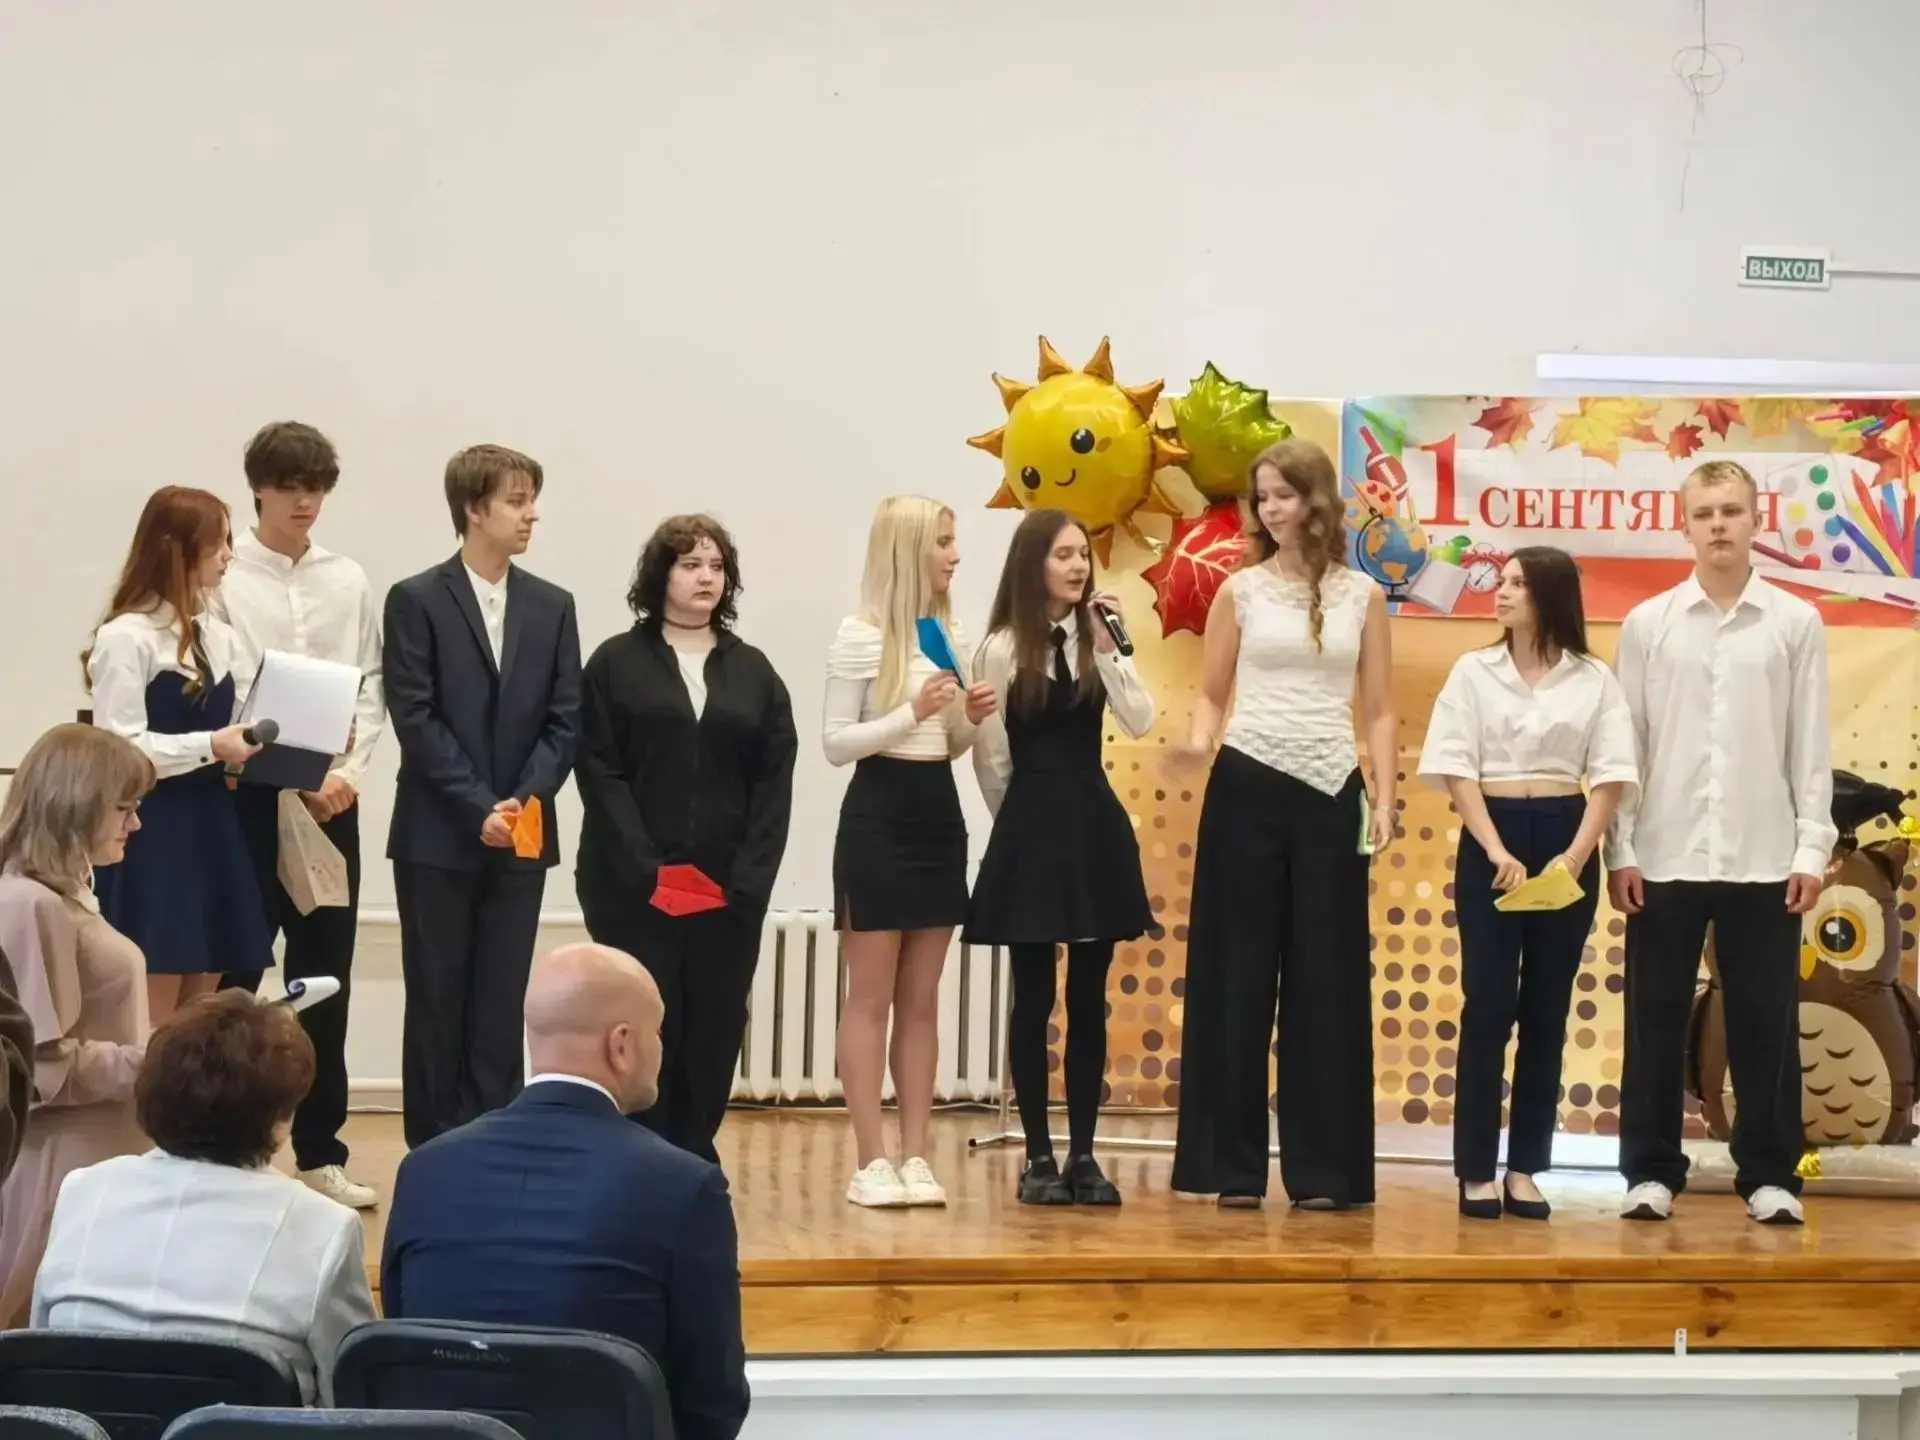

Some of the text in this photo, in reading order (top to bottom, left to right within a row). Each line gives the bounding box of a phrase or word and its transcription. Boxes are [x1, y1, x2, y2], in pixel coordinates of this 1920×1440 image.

[1748, 259, 1821, 281] ВЫХОД
[1419, 432, 1783, 533] 1 СЕНТЯЯ
